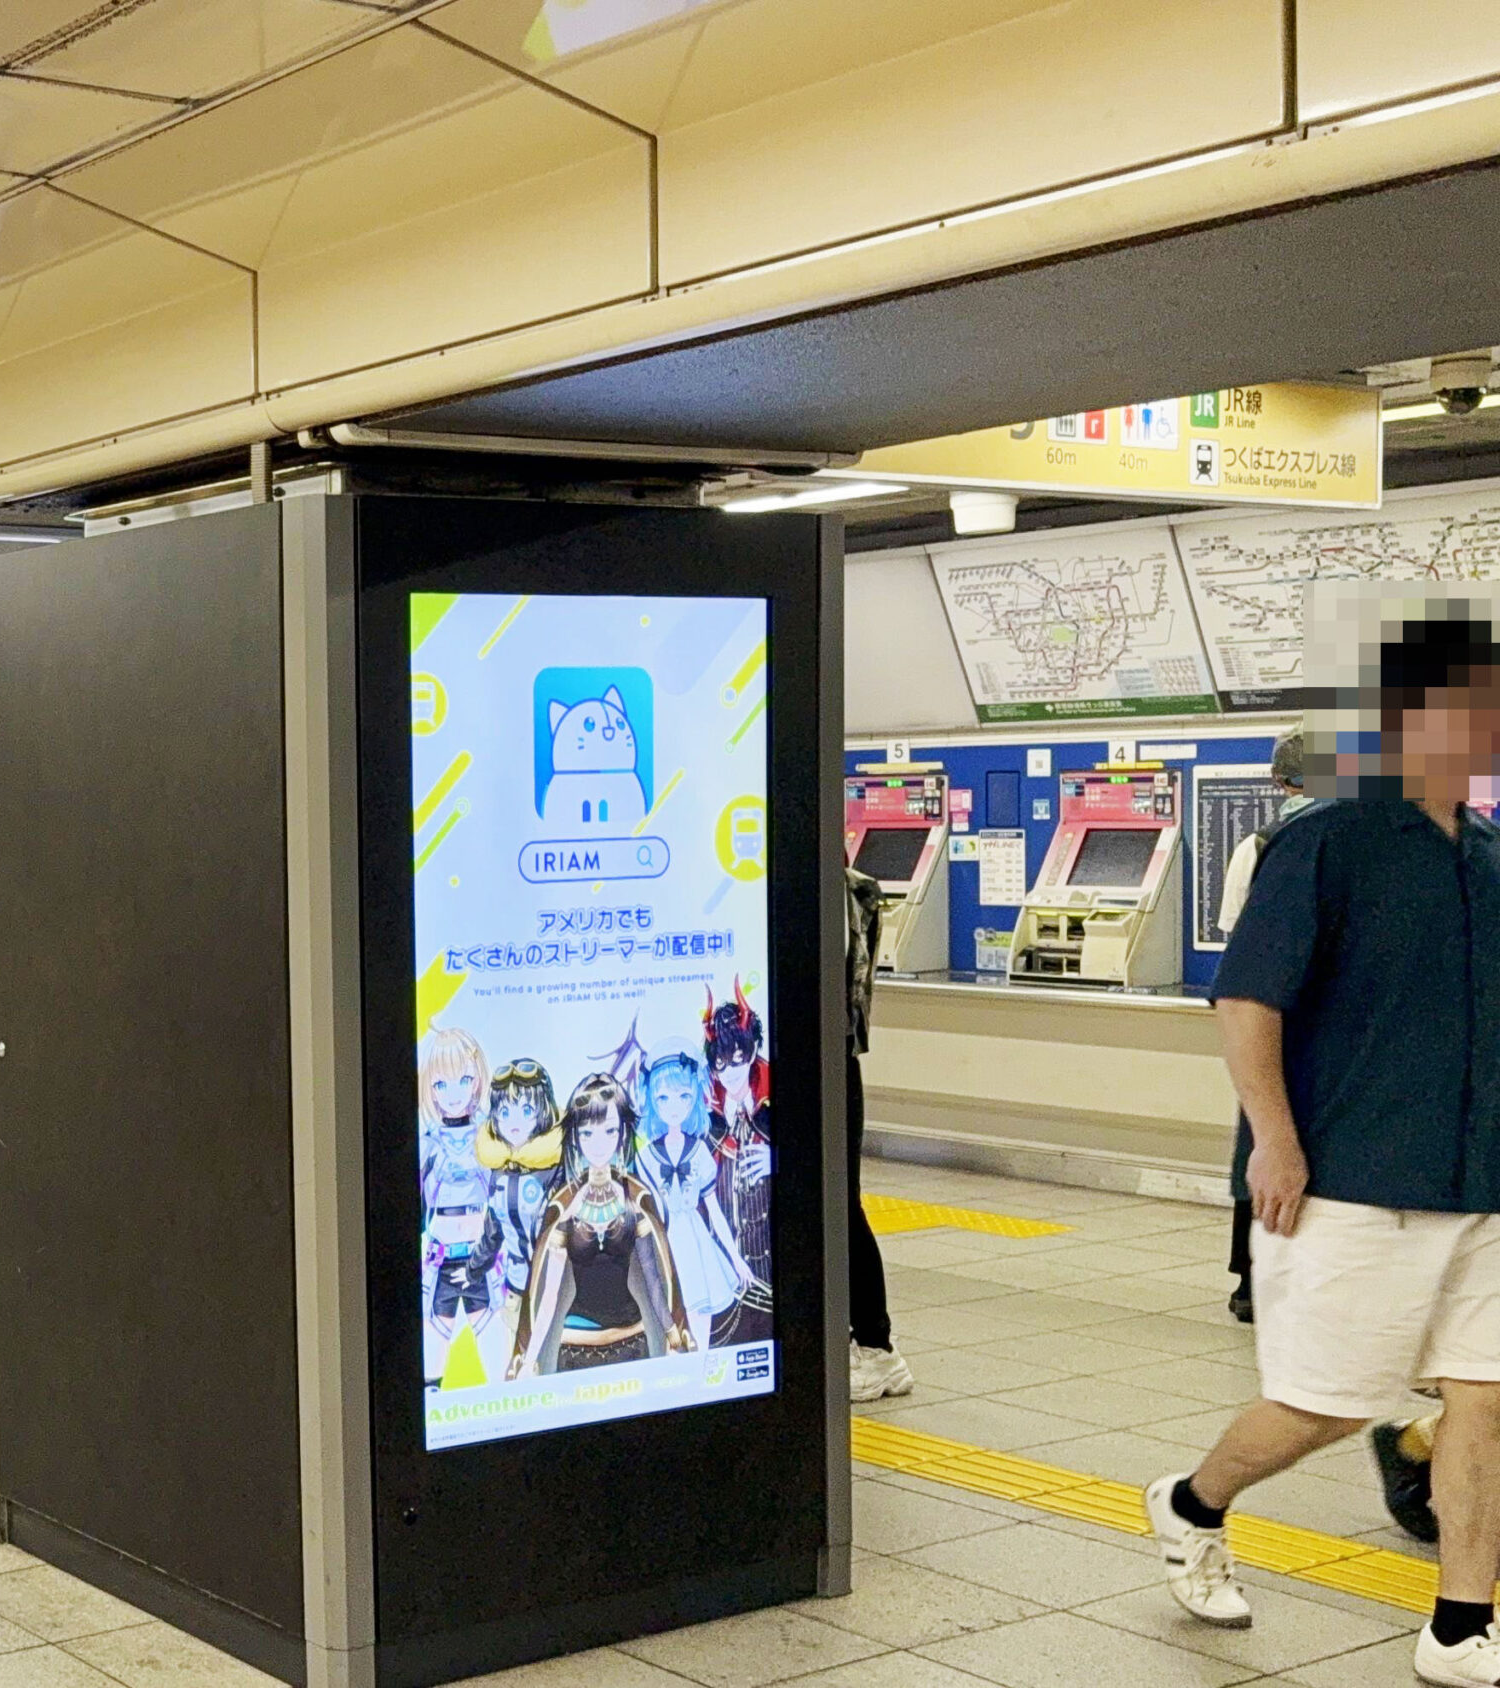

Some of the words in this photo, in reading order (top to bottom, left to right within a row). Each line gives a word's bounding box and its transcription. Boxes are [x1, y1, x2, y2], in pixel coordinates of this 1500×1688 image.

[1195, 393, 1214, 417] JR
[1225, 388, 1262, 415] JR線
[1225, 416, 1234, 428] JR
[1237, 417, 1256, 429] Line
[1047, 447, 1077, 465] 60m
[1119, 453, 1148, 471] 40m
[1224, 446, 1356, 478] つくばエクスプレス線
[1225, 472, 1261, 485] Tsukuba
[1263, 475, 1296, 489] Express
[1299, 477, 1317, 490] Line
[894, 743, 904, 759] 5
[1114, 746, 1125, 762] 4
[534, 850, 601, 873] IRIAM
[539, 908, 651, 932] アメリカでも
[474, 985, 501, 997] You'll
[504, 984, 524, 994] find
[536, 981, 576, 995] growing
[580, 979, 617, 990] number
[621, 978, 630, 988] of
[633, 976, 665, 988] unique
[668, 972, 714, 984] streamers
[562, 993, 591, 1003] IRIAM
[594, 992, 607, 1001] US
[610, 992, 621, 1000] as
[429, 1391, 555, 1424] Adventure
[573, 1376, 642, 1401] Japan
